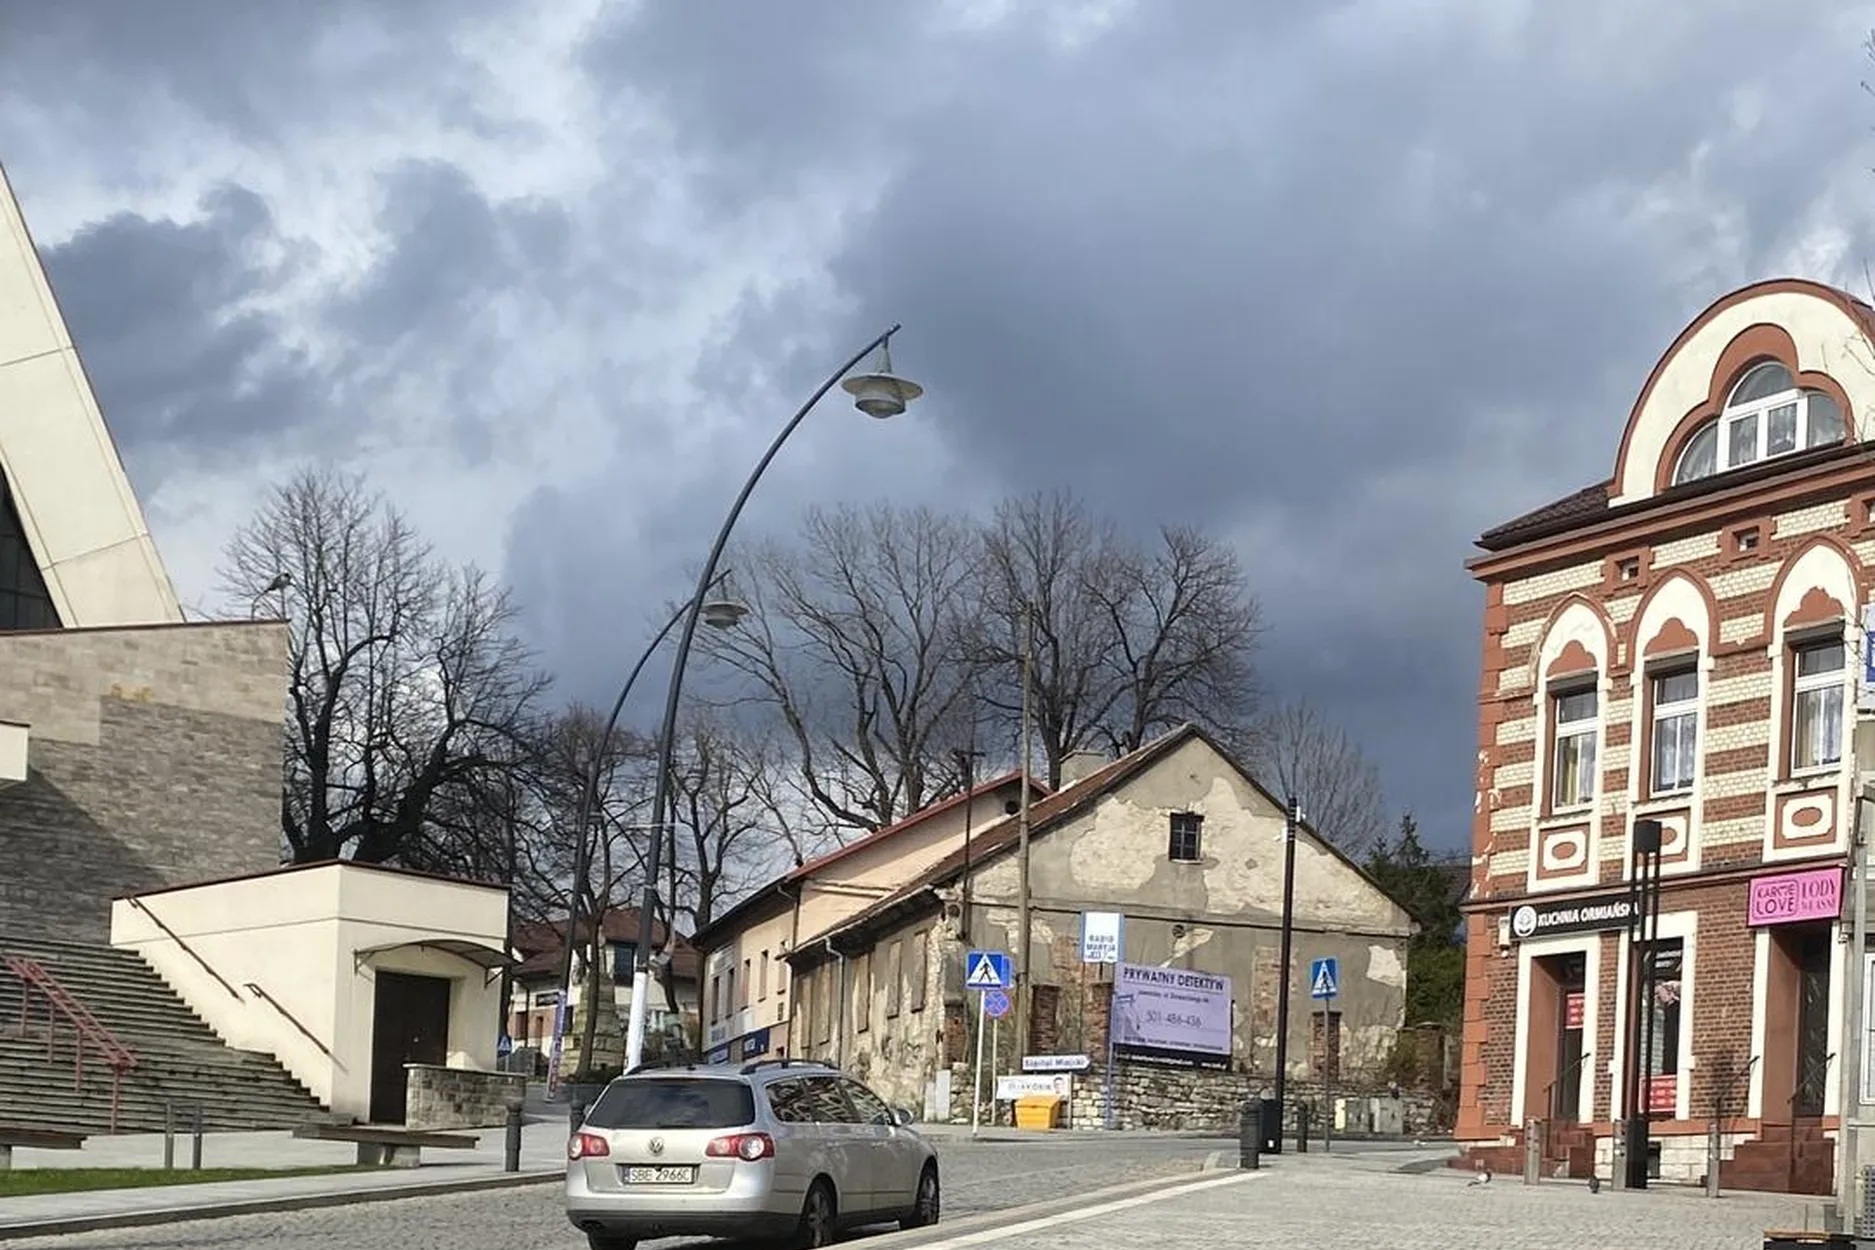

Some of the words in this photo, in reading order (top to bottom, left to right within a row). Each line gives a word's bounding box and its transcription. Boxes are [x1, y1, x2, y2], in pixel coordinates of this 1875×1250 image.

[1756, 896, 1793, 916] LOVE
[1537, 908, 1580, 927] KUCHNIA
[1123, 966, 1176, 985] PRYWATNY
[1177, 974, 1224, 991] DETEKTYW
